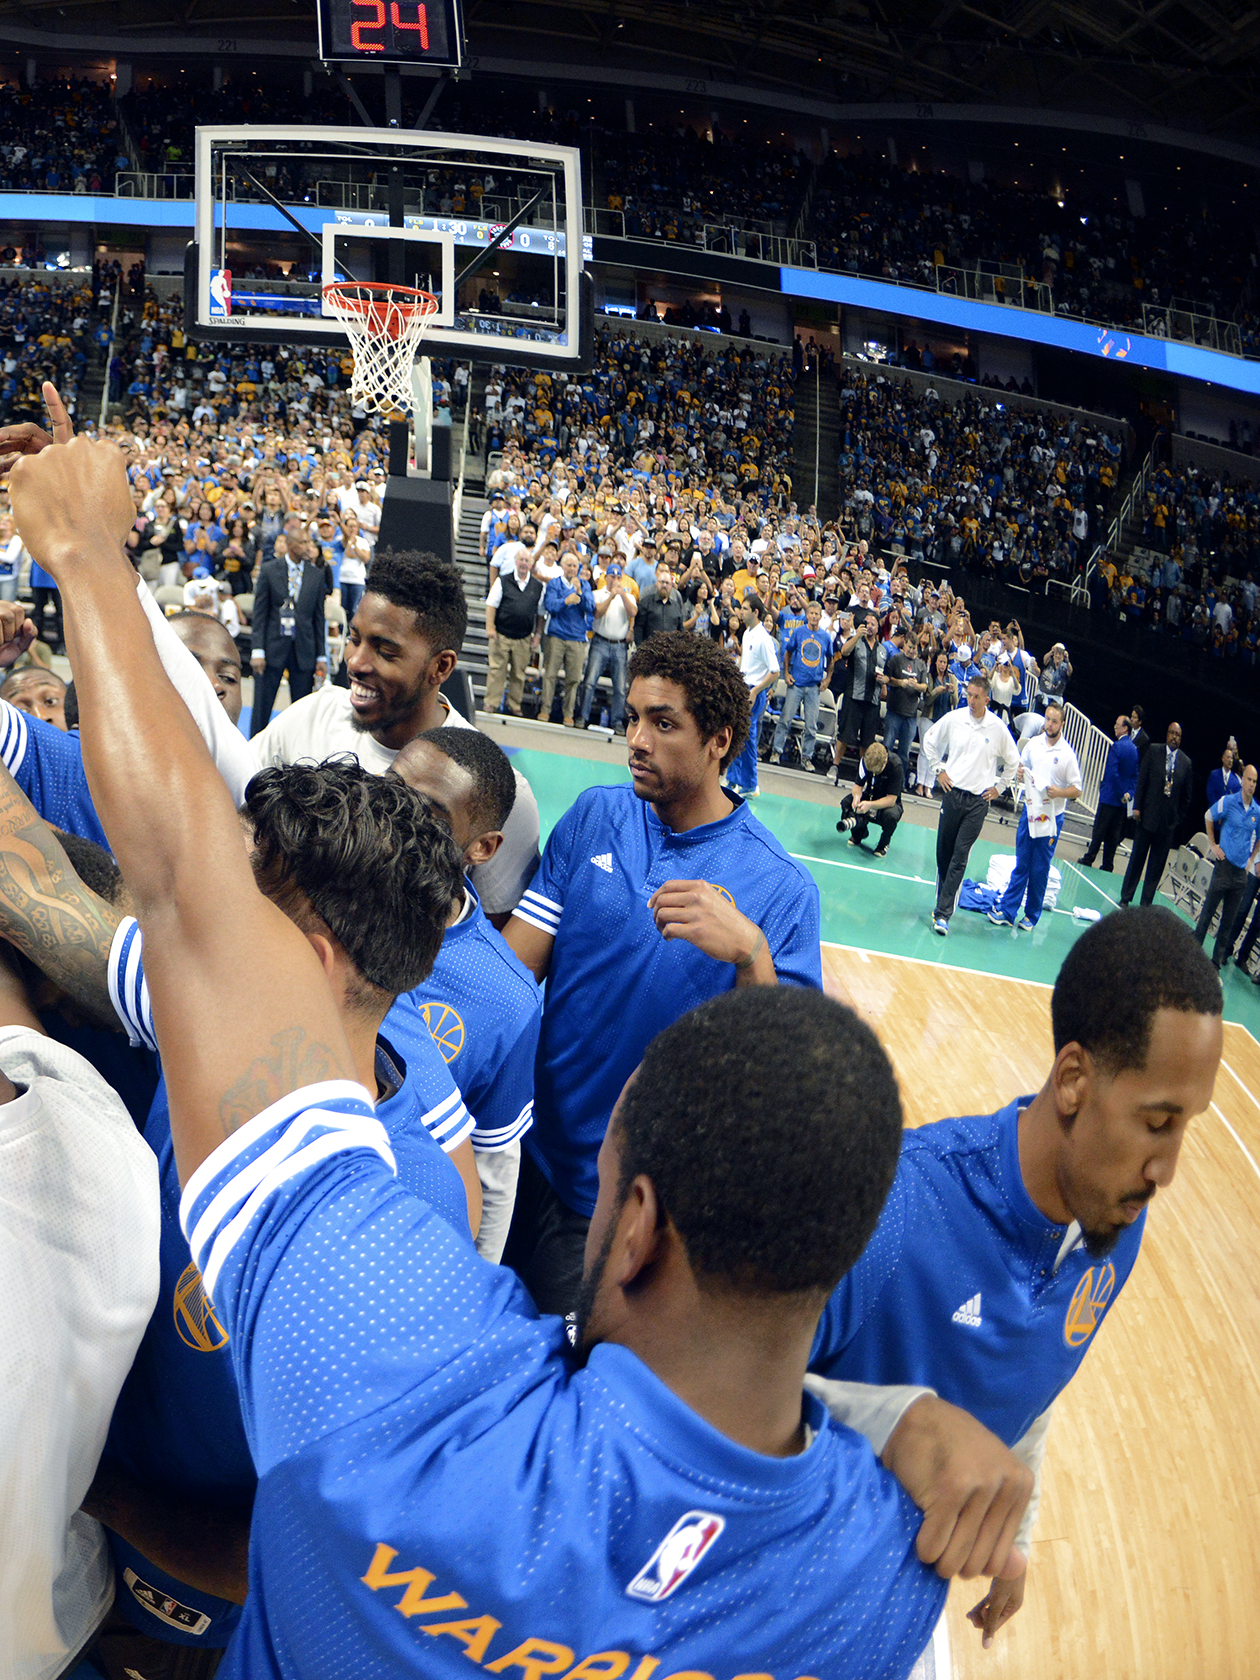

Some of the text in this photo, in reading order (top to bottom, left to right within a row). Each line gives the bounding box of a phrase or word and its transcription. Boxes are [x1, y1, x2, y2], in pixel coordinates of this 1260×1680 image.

[351, 0, 429, 50] 24
[217, 39, 237, 51] 221
[465, 57, 480, 69] 22
[684, 79, 707, 93] 223
[432, 219, 467, 236] 1:30
[520, 233, 530, 248] 0
[209, 317, 245, 326] SPALDING
[590, 857, 613, 873] adidas
[952, 1311, 982, 1327] adidas
[633, 1577, 661, 1596] NBA
[178, 1612, 191, 1624] XL
[360, 1542, 826, 1680] WARRI
